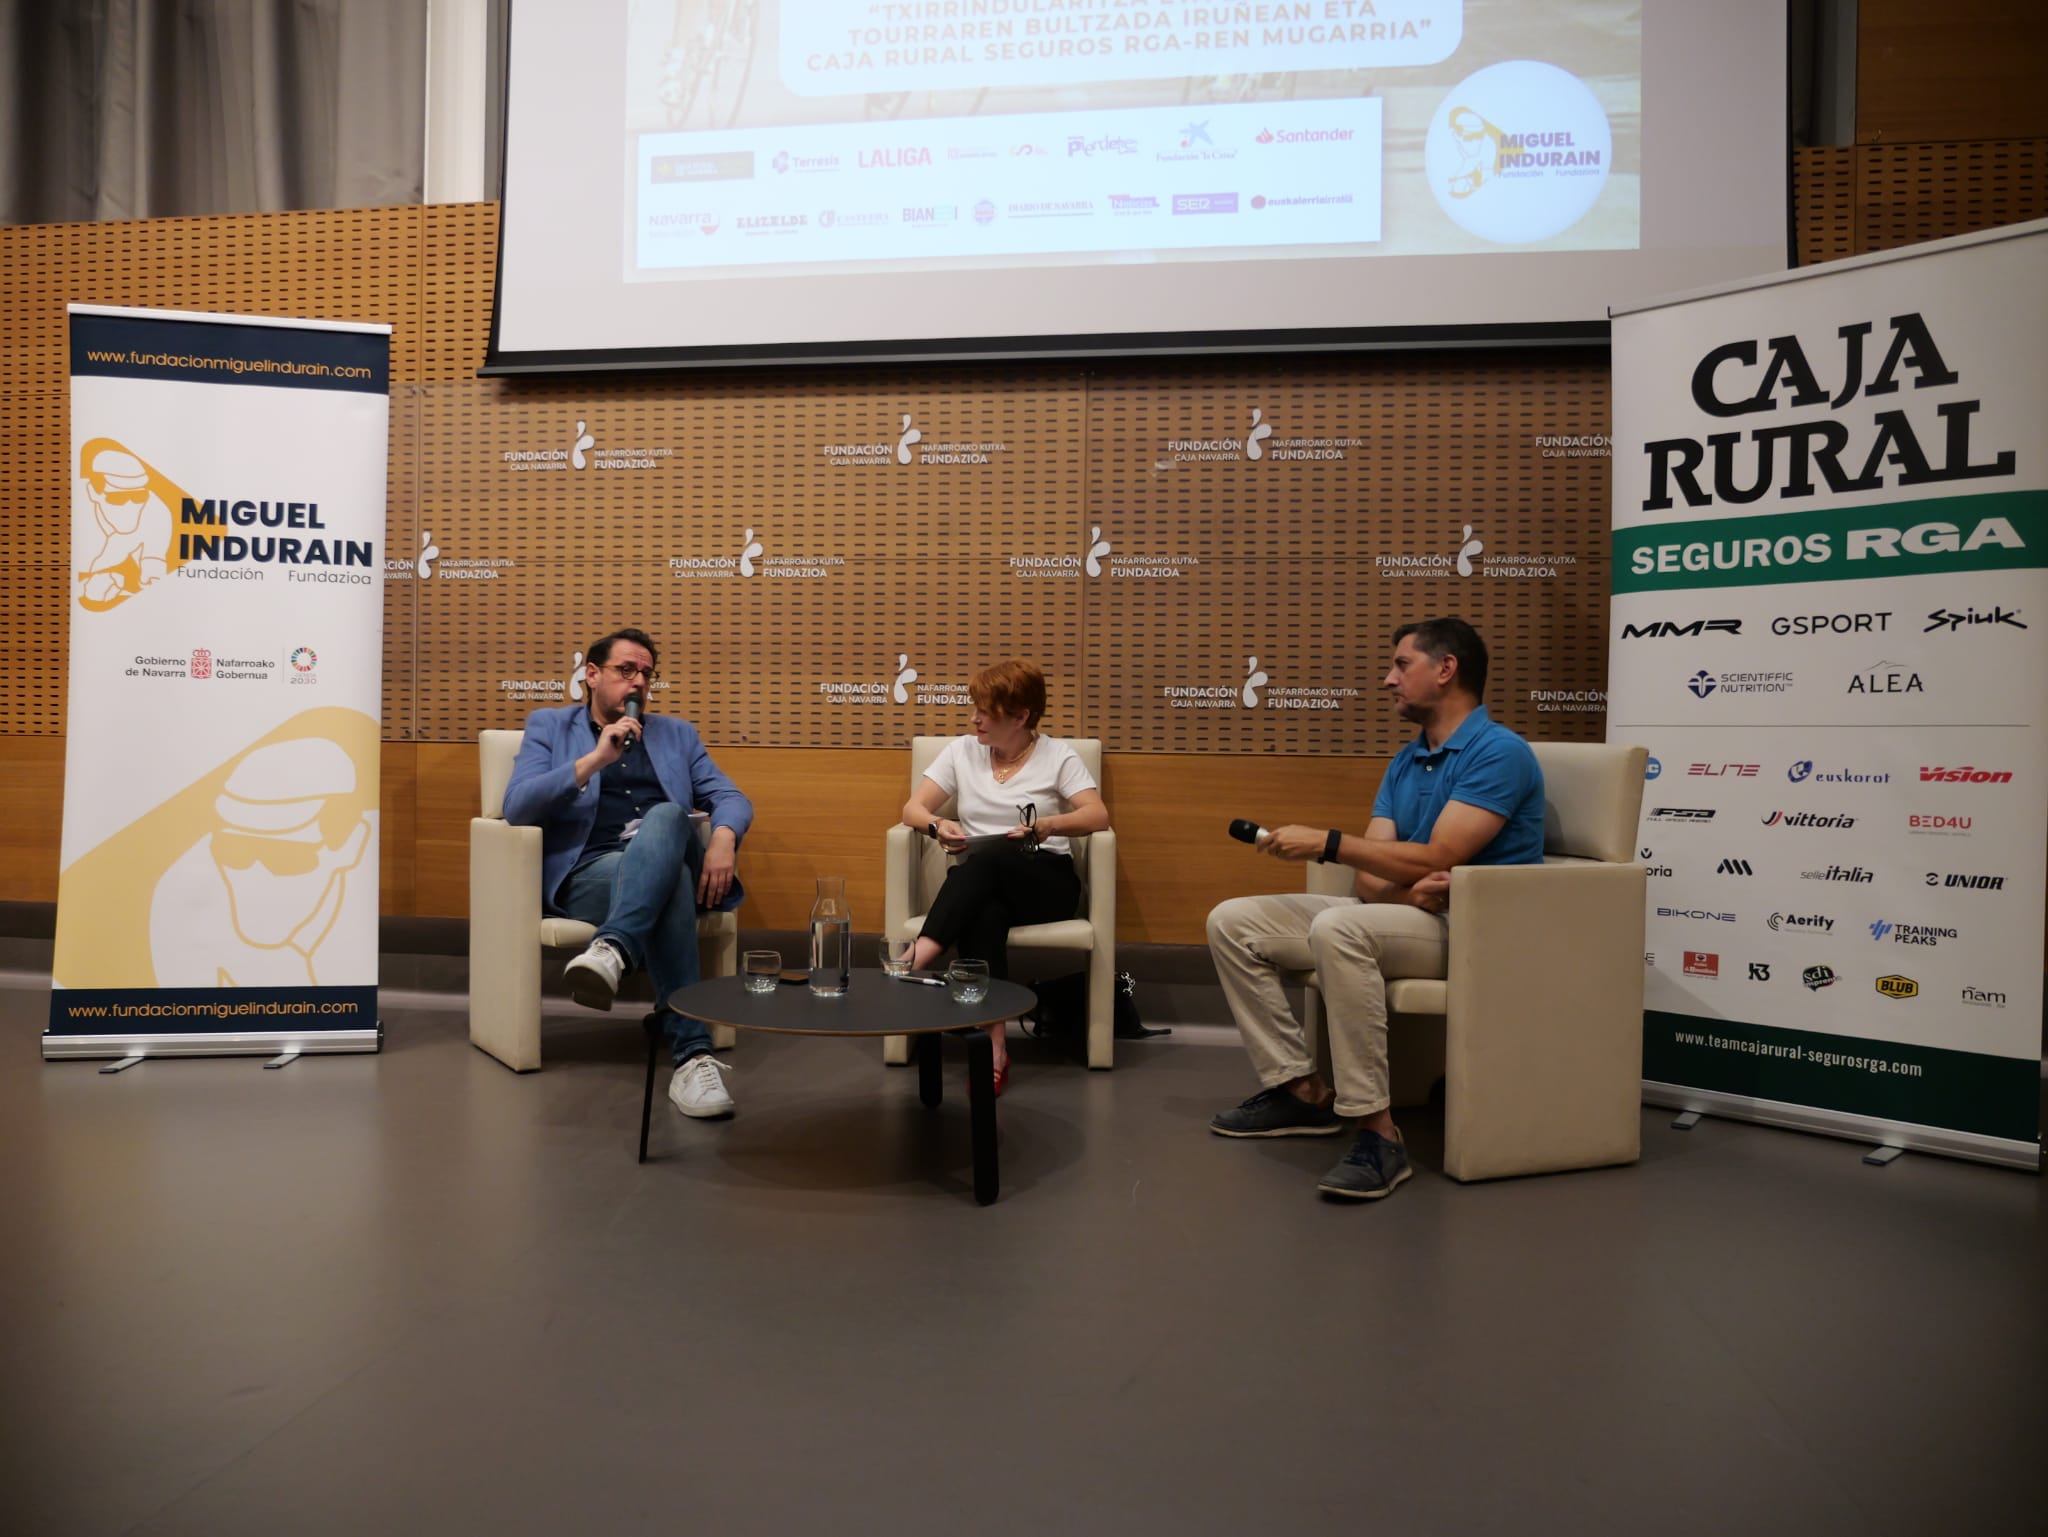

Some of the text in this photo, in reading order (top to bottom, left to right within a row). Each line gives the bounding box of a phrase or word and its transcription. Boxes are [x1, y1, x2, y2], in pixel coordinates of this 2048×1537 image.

[848, 0, 1376, 46] TOURRAREN BULTZADA IRUÑEAN ETA
[806, 51, 874, 72] CAJA
[885, 45, 974, 67] RURAL
[984, 37, 1113, 61] SEGUROS
[1124, 30, 1250, 53] RGA-REN
[1276, 128, 1354, 144] Santander
[1500, 132, 1575, 149] MIGUEL
[857, 147, 932, 170] LALIGA
[1500, 150, 1600, 168] INDURAIN
[87, 349, 371, 379] www.fundacionmiguelindurain.com
[1691, 312, 1958, 417] CAJA
[1168, 438, 1242, 451] FUNDACIÓN
[1535, 433, 1612, 447] FUNDACIÓN
[504, 449, 569, 461] FUNDACIÓN
[824, 443, 893, 456] FUNDACIÓN
[1272, 449, 1344, 460] FUNDAZIOA
[1542, 449, 1612, 458] CAJA NAVARRA
[1642, 399, 2016, 512] RURAL
[594, 458, 657, 470] FUNDAZIOA
[830, 457, 892, 466] CAJA NAVARRA
[921, 454, 988, 465] FUNDAZIOA
[1174, 453, 1240, 462] CAJA NAVARRA
[510, 462, 568, 471] CAJA NAVARRA
[180, 497, 325, 530] MIGUEL
[179, 534, 373, 567] INDURAIN
[1630, 516, 2026, 575] SEGUROS RGA
[669, 557, 736, 569] FUNDACIÓN
[1009, 555, 1082, 568] FUNDACIÓN
[1375, 554, 1452, 567] FUNDACIÓN
[177, 565, 372, 585] Fundación Fundazioa
[439, 569, 499, 579] FUNDAZIOA
[675, 570, 735, 578] CAJA NAVARRA
[763, 568, 828, 578] FUNDAZIOA
[1016, 570, 1080, 578] CAJA NAVARRA
[1111, 567, 1180, 578] FUNDAZIOA
[1382, 569, 1450, 577] CAJA NAVARRA
[1483, 567, 1557, 577] FUNDAZIOA
[1621, 619, 1742, 639] MMR
[1771, 612, 1892, 636] GSPORT
[135, 655, 186, 666] Gobierno
[216, 658, 275, 669] Nafarroako
[125, 668, 186, 678] de Navarra
[216, 670, 268, 680] Gobernua
[501, 678, 565, 690] FUNDACIÓN
[820, 682, 889, 693] FUNDACIÓN
[1847, 673, 1924, 694] ALEA
[507, 692, 564, 700] CAJA NAVARRA
[1164, 685, 1238, 698] FUNDACIÓN
[1530, 689, 1608, 701] FUNDACIÓN
[826, 695, 847, 703] CAJA
[1170, 699, 1236, 708] CAJA NAVARRA
[1268, 698, 1339, 709] FUNDAZIOA
[1537, 703, 1607, 712] CAJA NAVARRA
[1784, 812, 1854, 828] vittoria
[1909, 815, 1971, 829] BED4U
[1944, 874, 2004, 890] UNIOR
[1656, 907, 1736, 922] BIKONE
[1786, 914, 1834, 931] Aerify
[1895, 924, 1957, 938] TRAINING
[1894, 934, 1937, 946] PEAKS
[1880, 980, 1914, 994] BLUB
[1961, 986, 2006, 1004] ñam
[1675, 1029, 1923, 1077] www.teamcajarural-segurosrga.com
